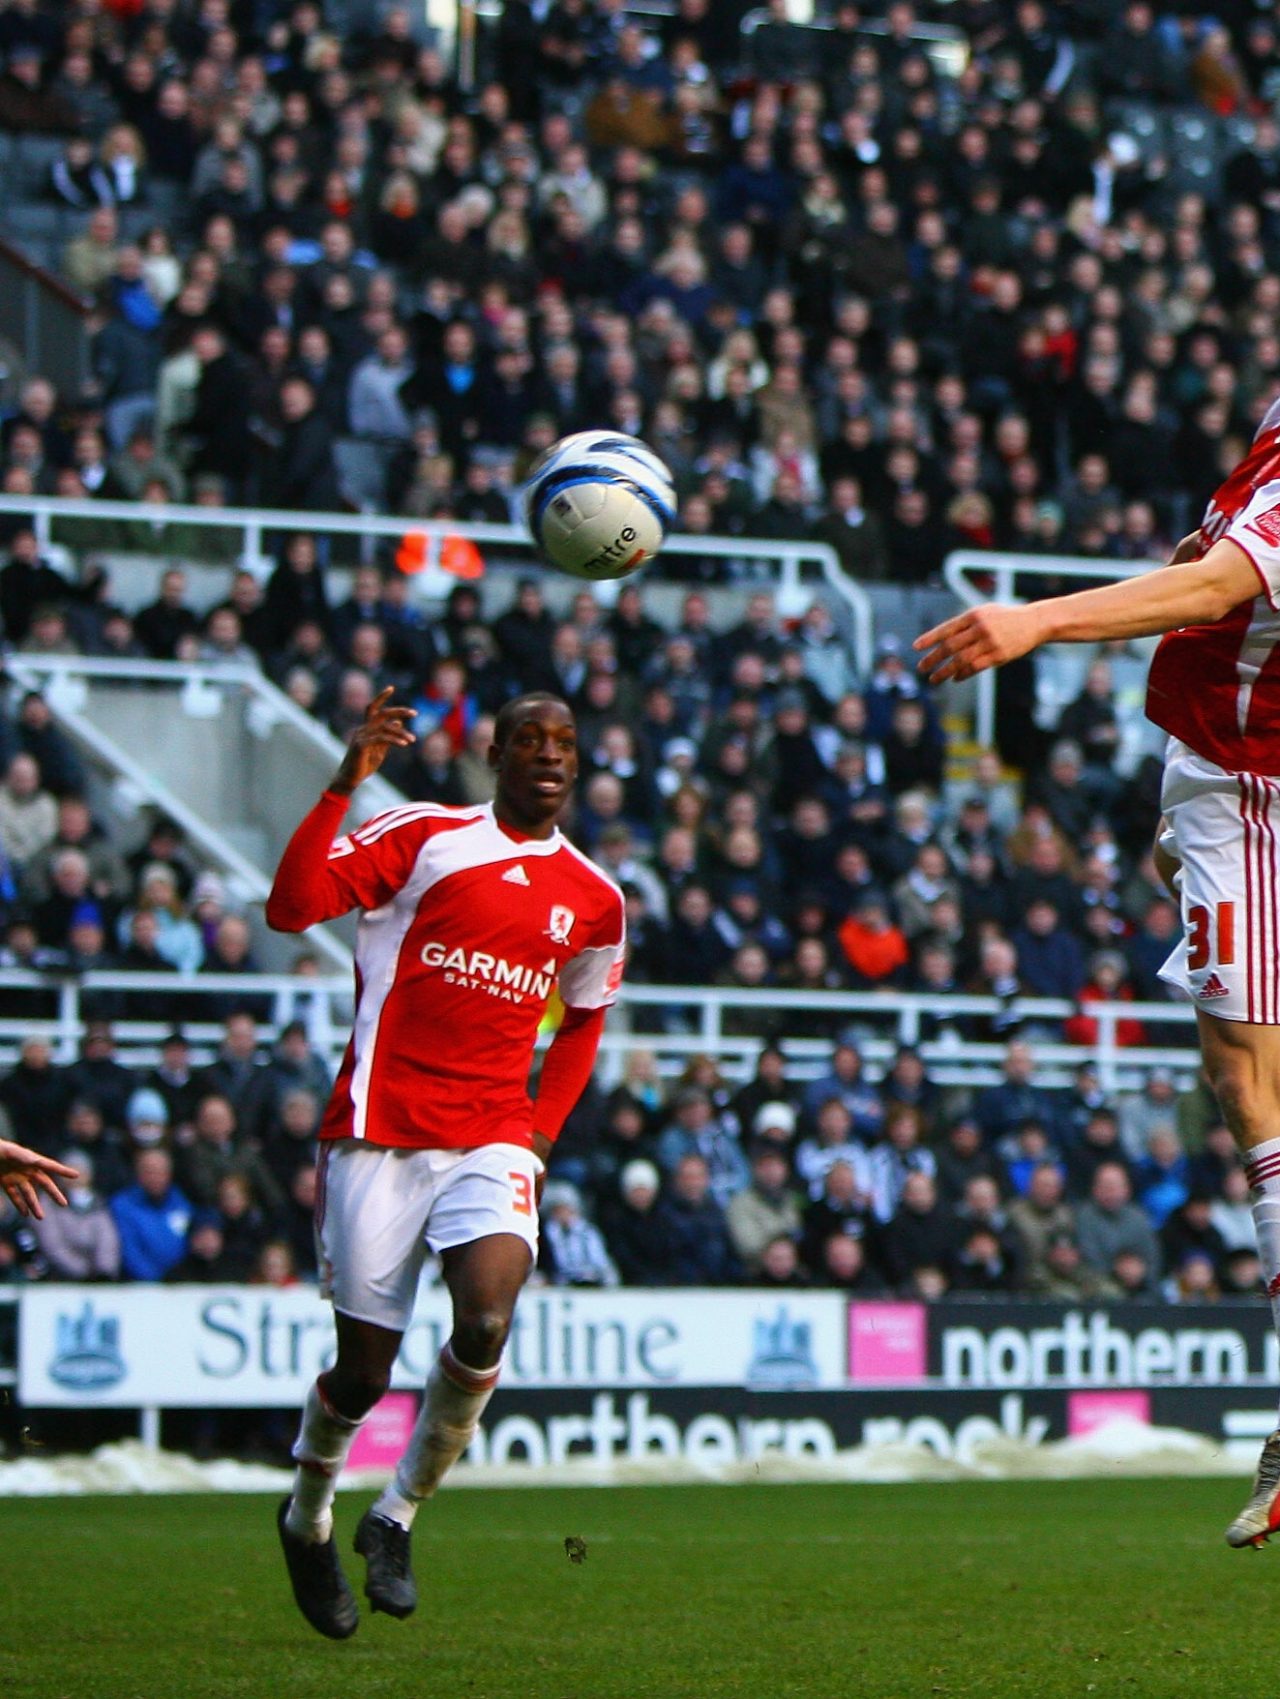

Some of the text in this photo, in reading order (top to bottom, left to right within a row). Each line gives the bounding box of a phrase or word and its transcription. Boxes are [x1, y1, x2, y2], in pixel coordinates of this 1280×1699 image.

[584, 526, 637, 573] mitre
[1187, 901, 1235, 971] 31
[420, 942, 551, 1000] GARMIN
[444, 972, 524, 1004] SAT-NAV
[508, 1171, 532, 1217] 3
[197, 1295, 681, 1380] Strgtline
[942, 1311, 1247, 1386] northern
